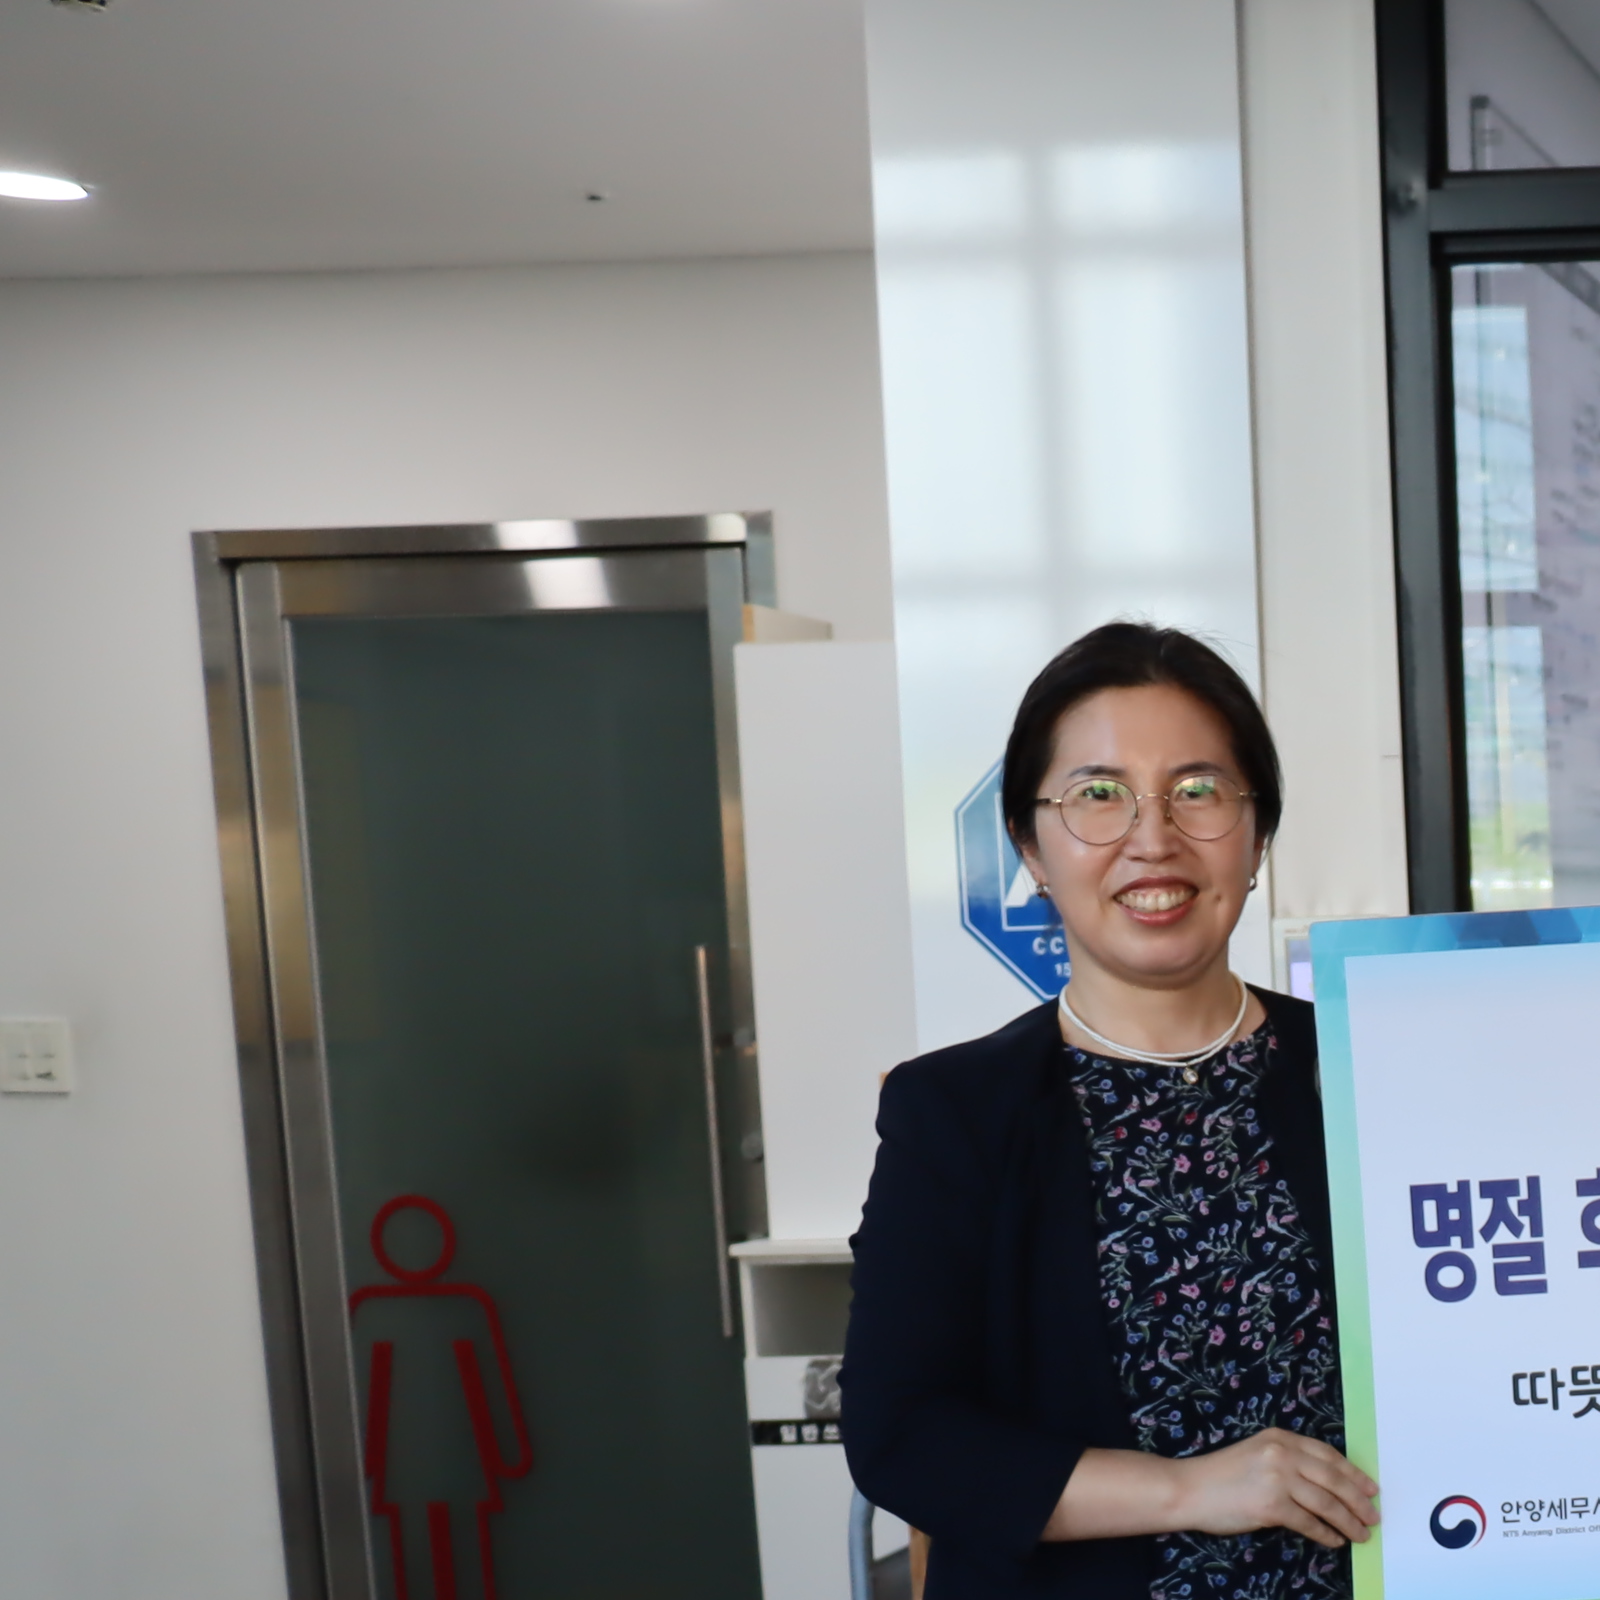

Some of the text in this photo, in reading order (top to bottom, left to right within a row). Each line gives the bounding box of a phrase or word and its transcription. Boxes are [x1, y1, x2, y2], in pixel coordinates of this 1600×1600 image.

[1409, 1174, 1550, 1303] 명절
[1502, 1530, 1519, 1539] NTS
[1521, 1528, 1553, 1540] Anyang
[1555, 1526, 1586, 1536] District
